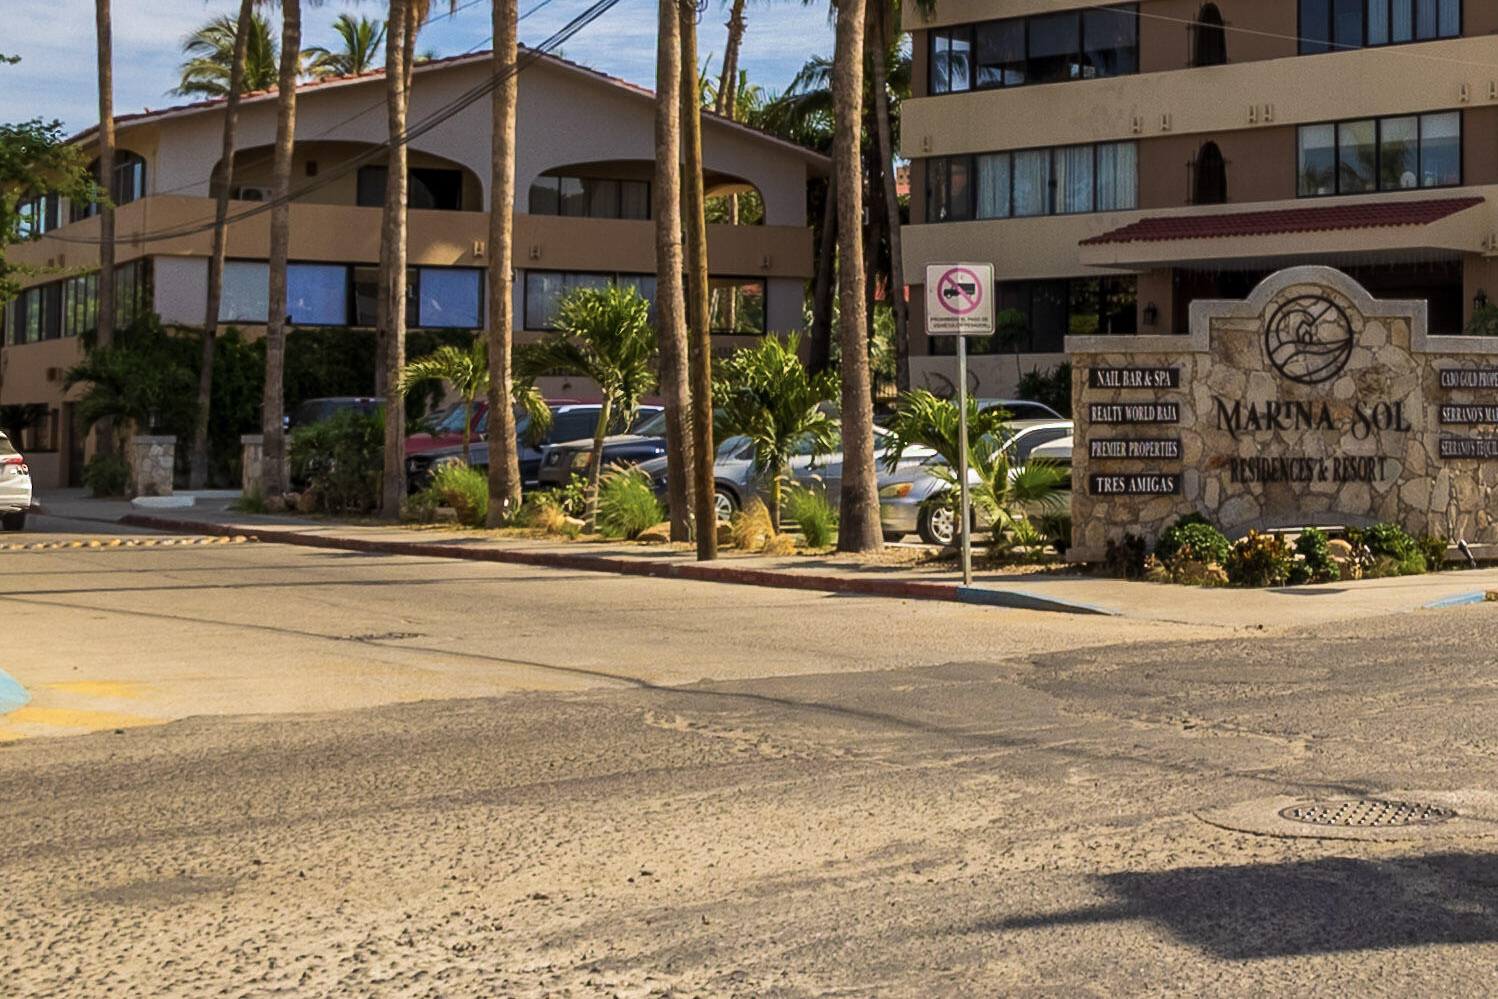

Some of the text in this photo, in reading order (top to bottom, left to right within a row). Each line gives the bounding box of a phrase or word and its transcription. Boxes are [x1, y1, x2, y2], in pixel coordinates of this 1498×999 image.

[1097, 370, 1171, 386] NAIL BAR & SPA
[1091, 406, 1176, 421] REALTY WORLD BAJA
[1214, 396, 1411, 441] MARINA SOL
[1091, 442, 1177, 456] PREMIER PROPERTIES
[1230, 457, 1387, 482] RESIDENCES & RESORT
[1096, 477, 1174, 492] TRES AMIGAS
